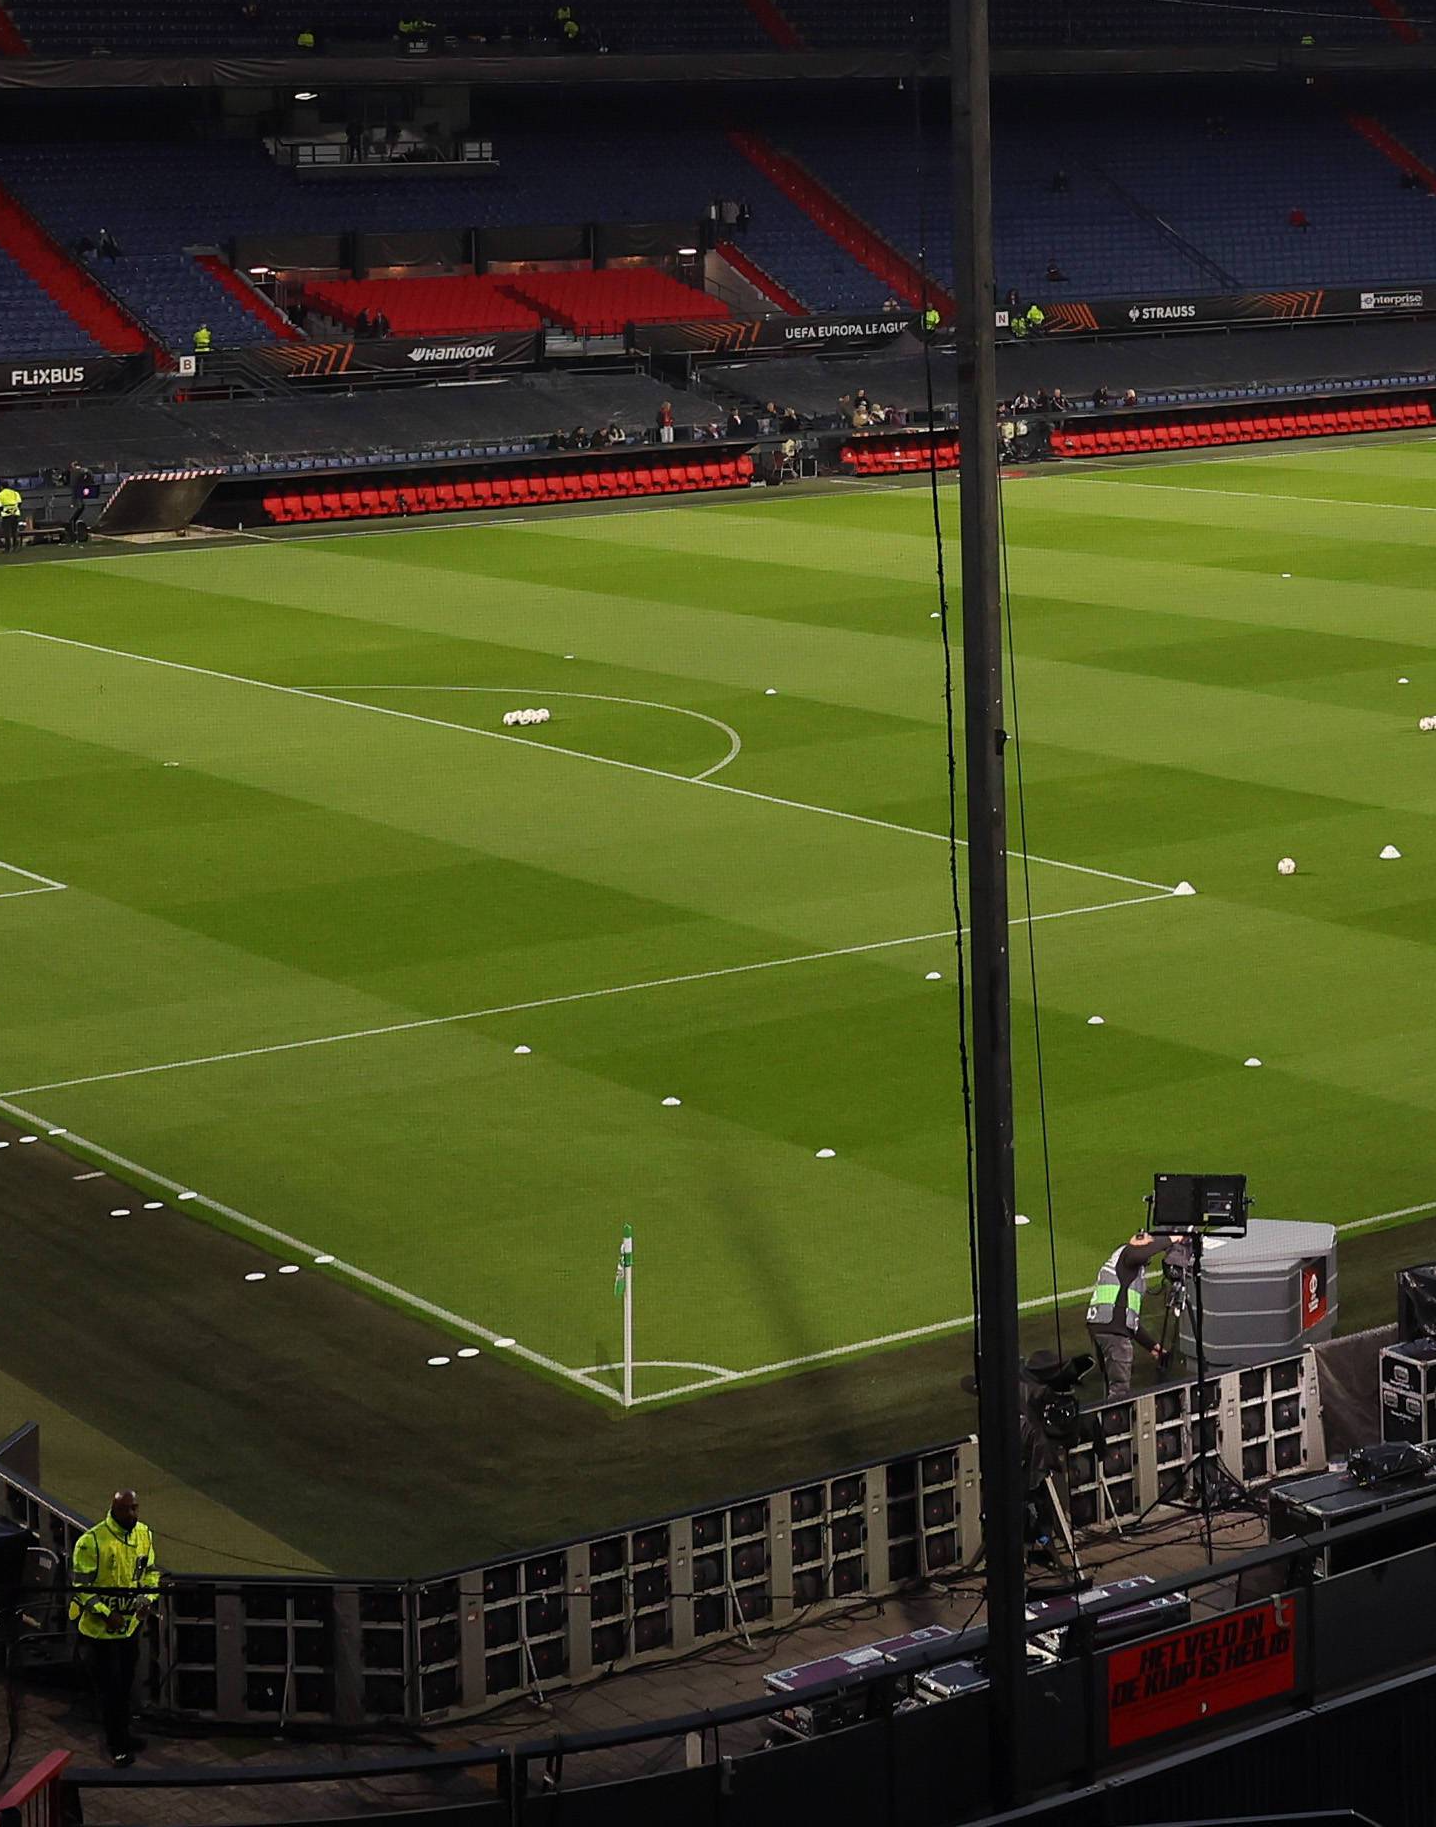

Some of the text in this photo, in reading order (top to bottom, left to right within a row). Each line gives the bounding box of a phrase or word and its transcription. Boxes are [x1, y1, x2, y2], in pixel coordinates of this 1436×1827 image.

[1141, 304, 1196, 320] STRAUSS
[784, 326, 817, 340] UEFA
[818, 323, 864, 338] EUROPA
[183, 358, 192, 370] B
[1140, 1638, 1182, 1675] HET
[1183, 1621, 1239, 1657] VELD
[1112, 1675, 1141, 1709] DE
[1198, 1648, 1224, 1679] IS
